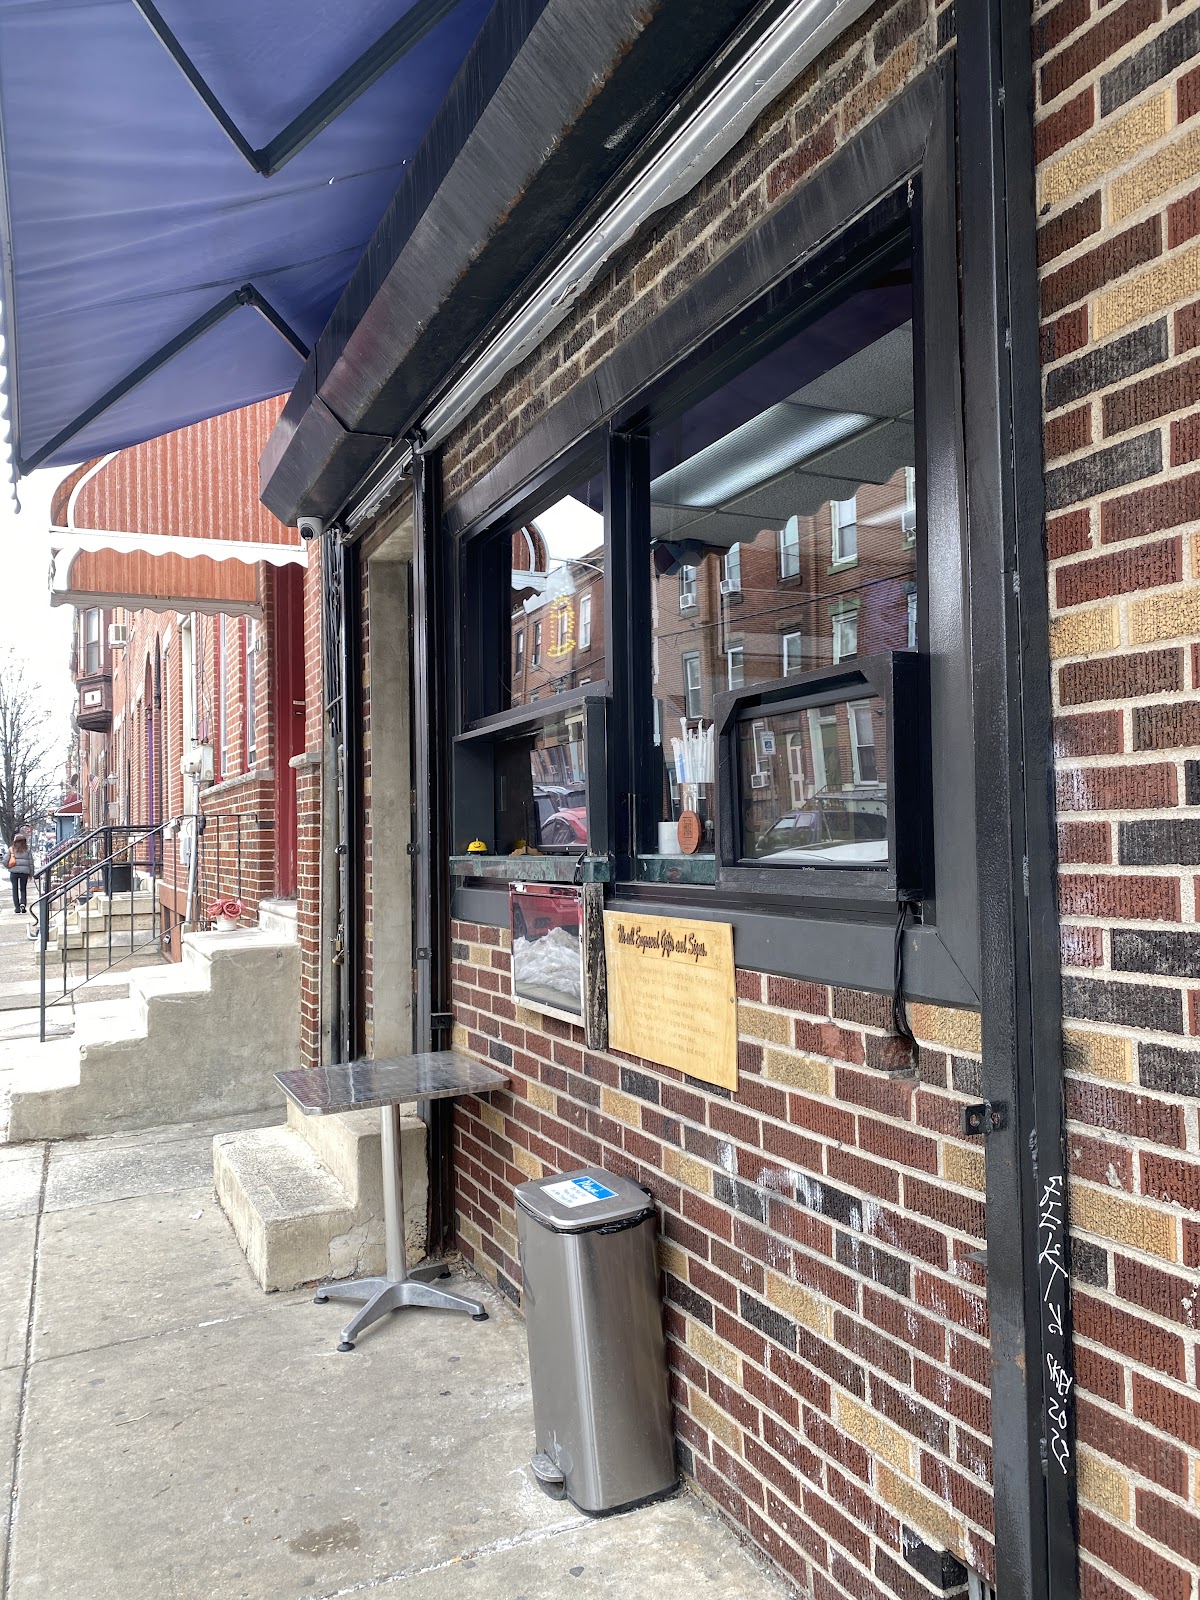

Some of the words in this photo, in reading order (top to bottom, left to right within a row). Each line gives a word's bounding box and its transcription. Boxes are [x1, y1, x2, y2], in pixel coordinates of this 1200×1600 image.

[635, 925, 660, 954] Engraved
[661, 929, 675, 958] Gifts
[675, 934, 688, 954] and
